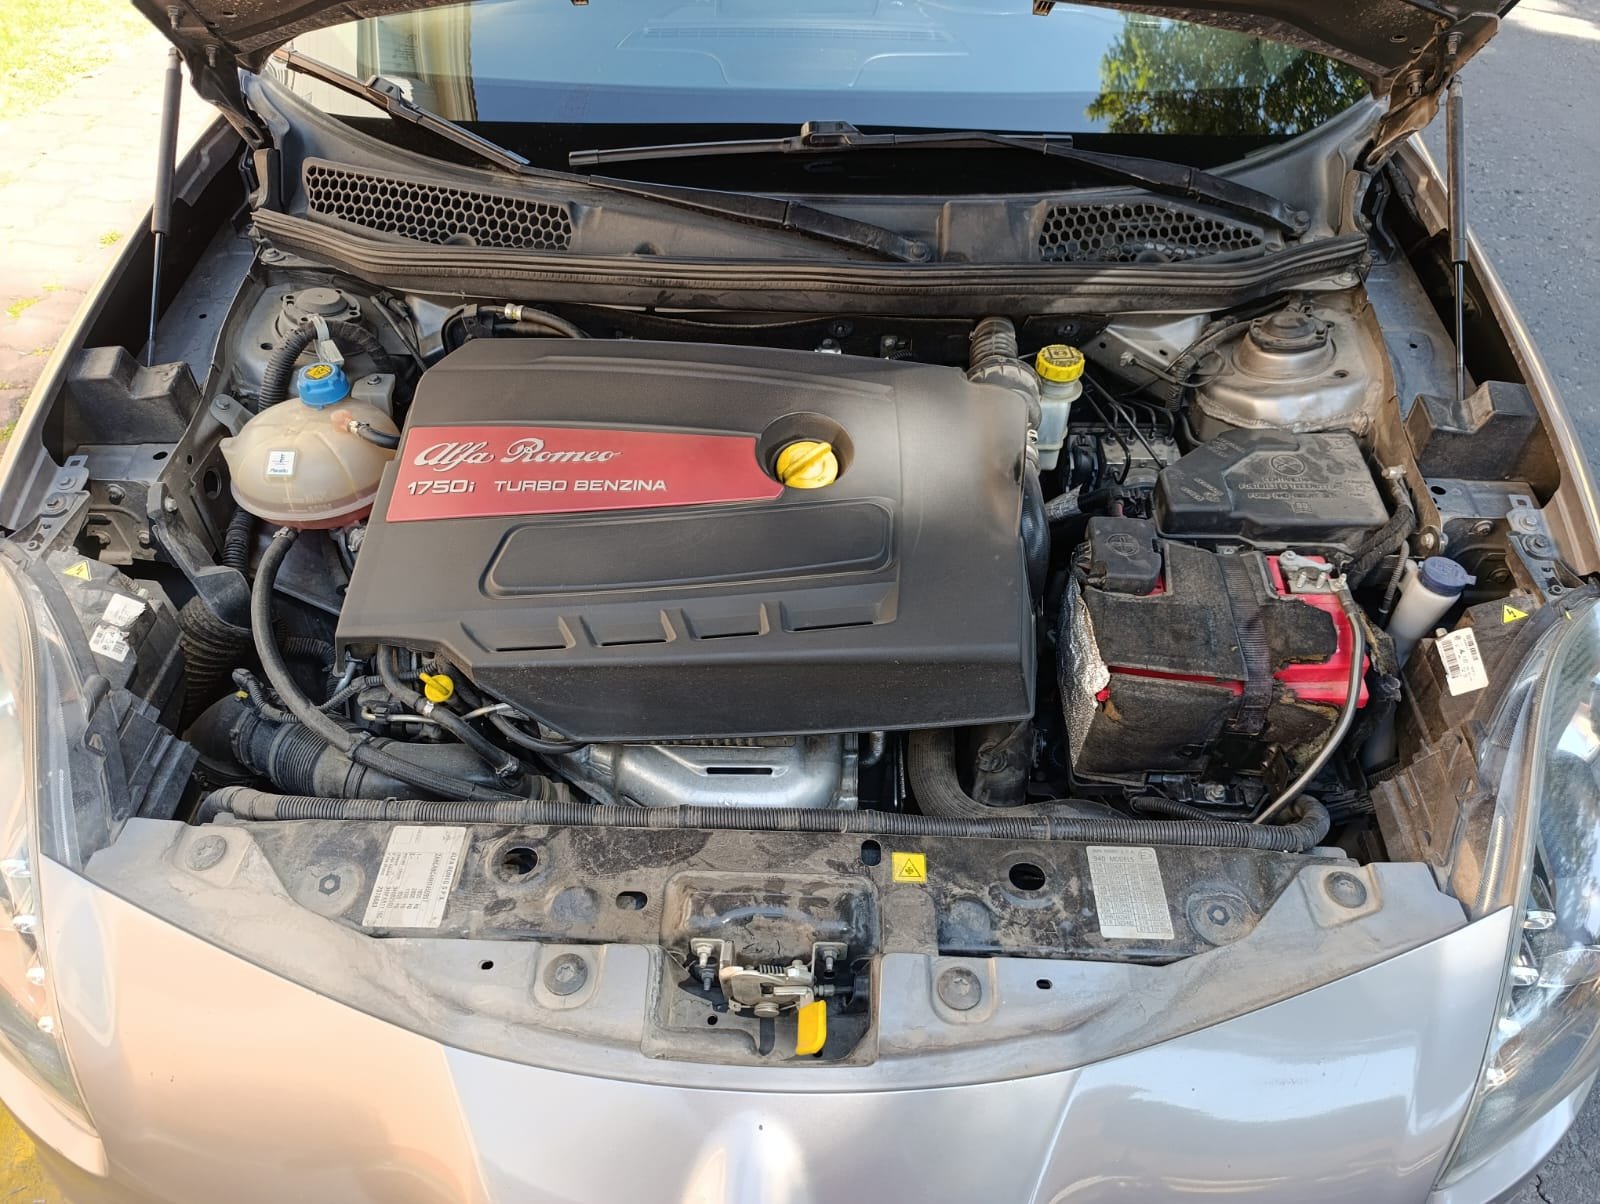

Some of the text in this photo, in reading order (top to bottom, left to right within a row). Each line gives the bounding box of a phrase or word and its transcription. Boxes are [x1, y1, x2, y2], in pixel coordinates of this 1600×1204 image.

[414, 437, 622, 472] Alfa Romeo
[407, 479, 668, 495] 1750i TURBO BENZINA
